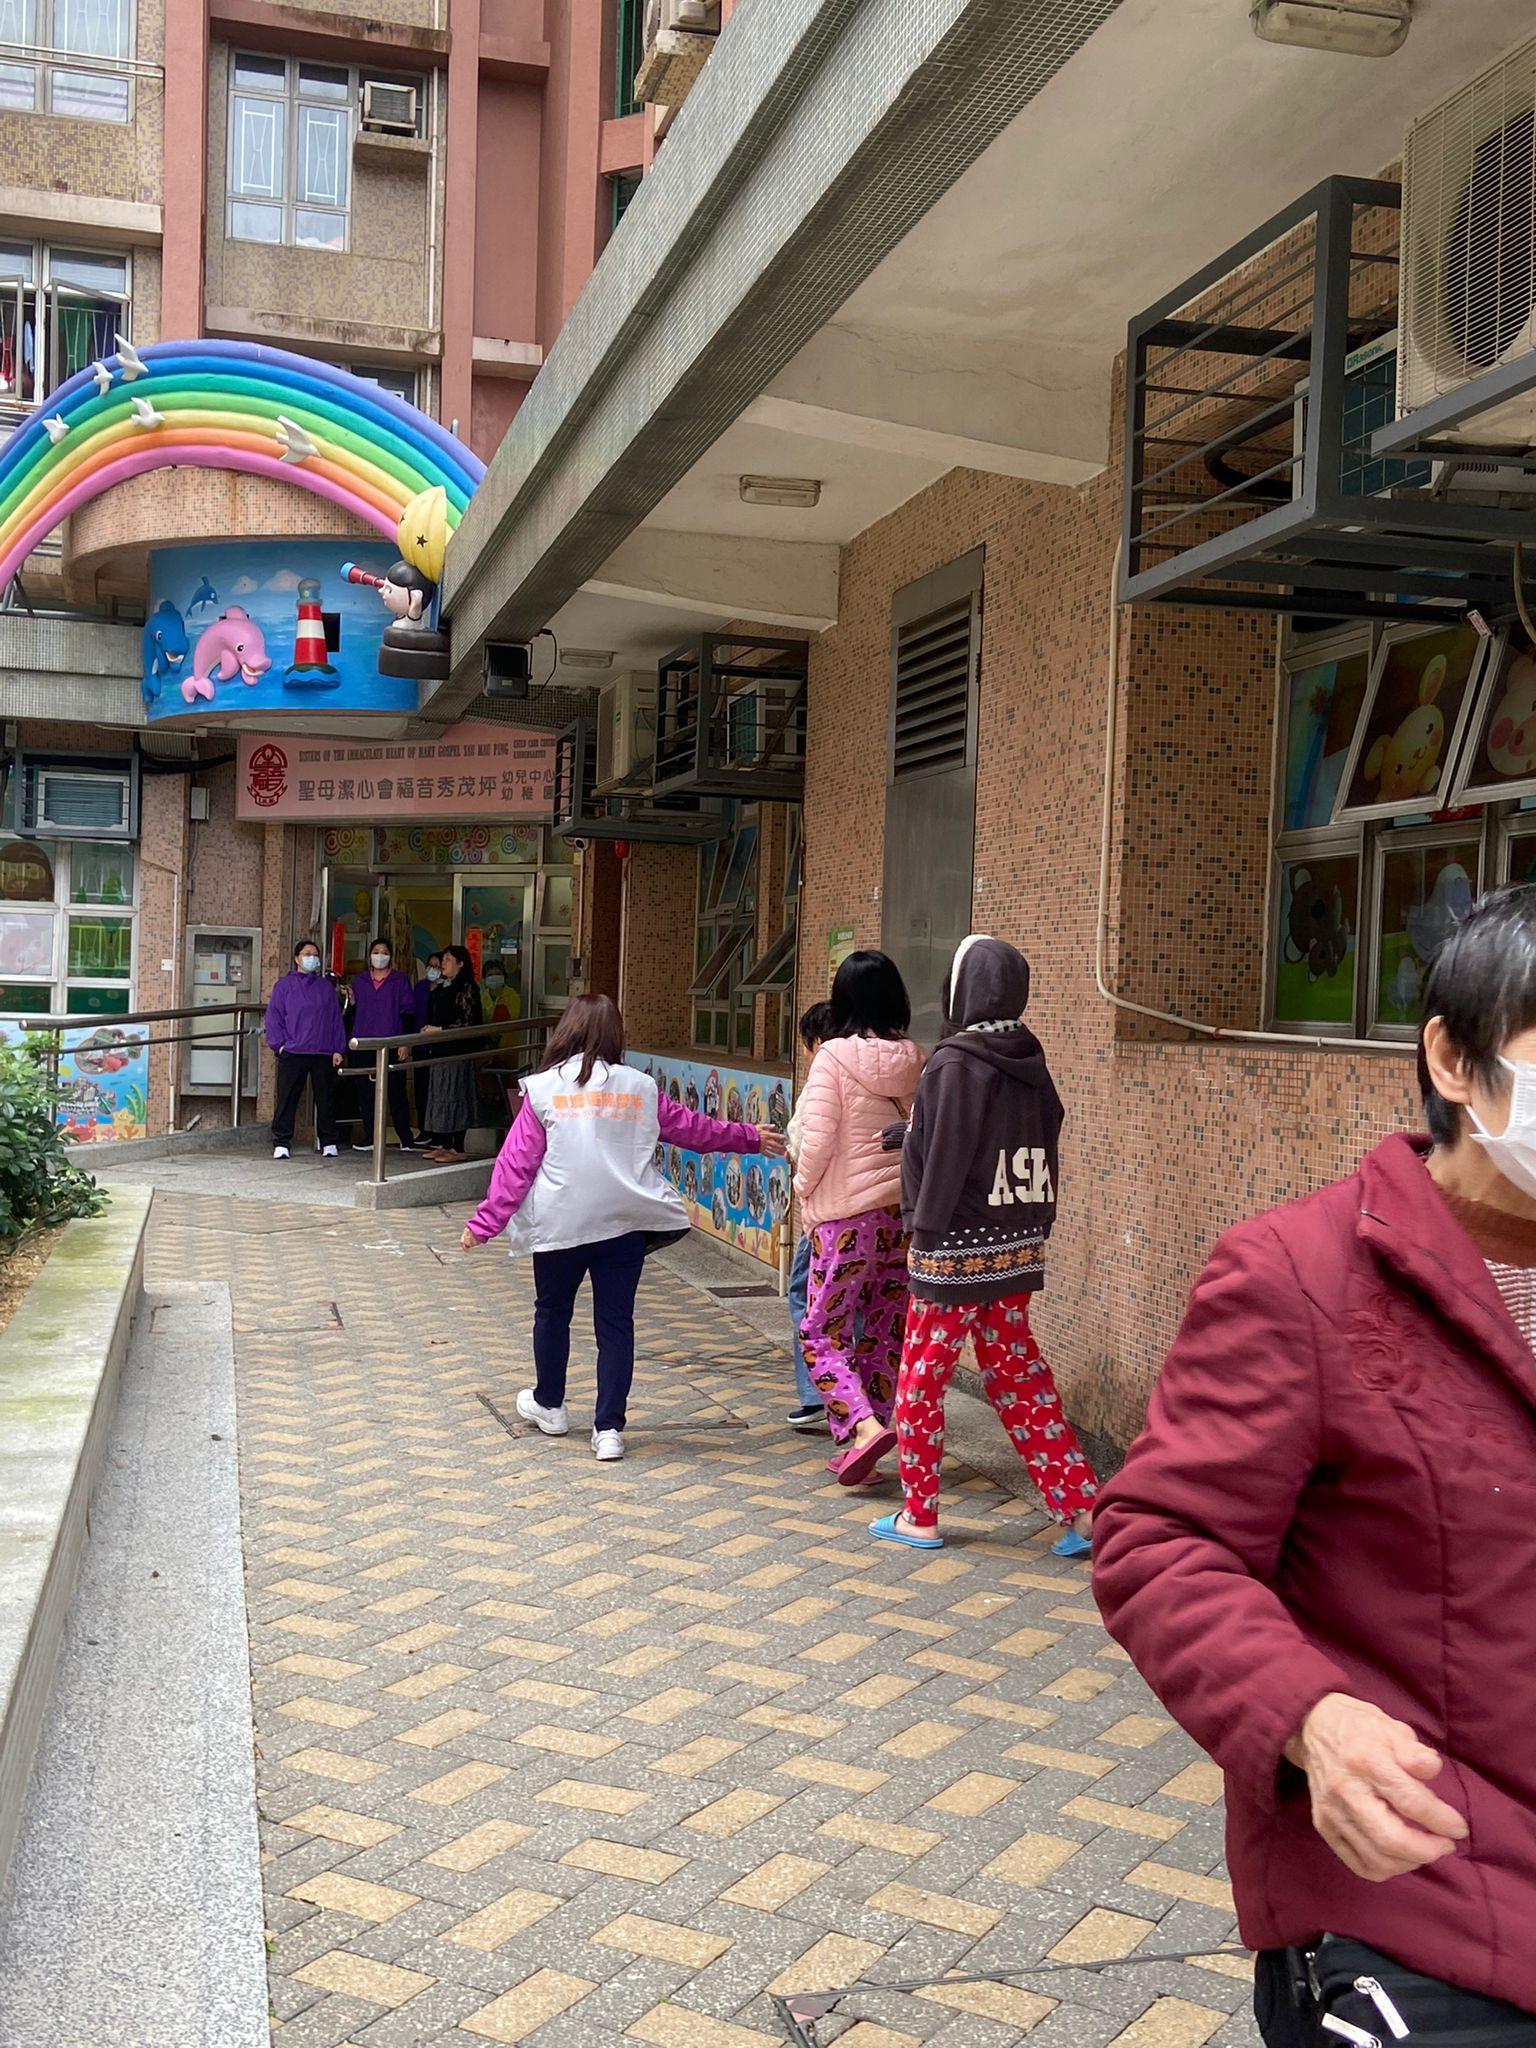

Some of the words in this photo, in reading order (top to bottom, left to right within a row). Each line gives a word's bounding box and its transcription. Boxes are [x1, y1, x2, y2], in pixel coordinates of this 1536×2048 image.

[299, 751, 321, 762] SISTERS
[323, 750, 331, 761] OF
[333, 749, 345, 761] THE
[347, 748, 383, 761] IMMACULATE
[385, 747, 405, 759] HEART
[408, 747, 416, 759] OF
[419, 746, 435, 758] MARY
[438, 745, 460, 757] GOSPEL
[464, 744, 476, 757] SAU
[477, 744, 491, 756] MAU
[493, 743, 509, 755] PING
[501, 769, 555, 785] 幼兒中心
[298, 776, 497, 801] 聖母潔心會福音秀茂坪
[501, 785, 554, 801] 幼稚園
